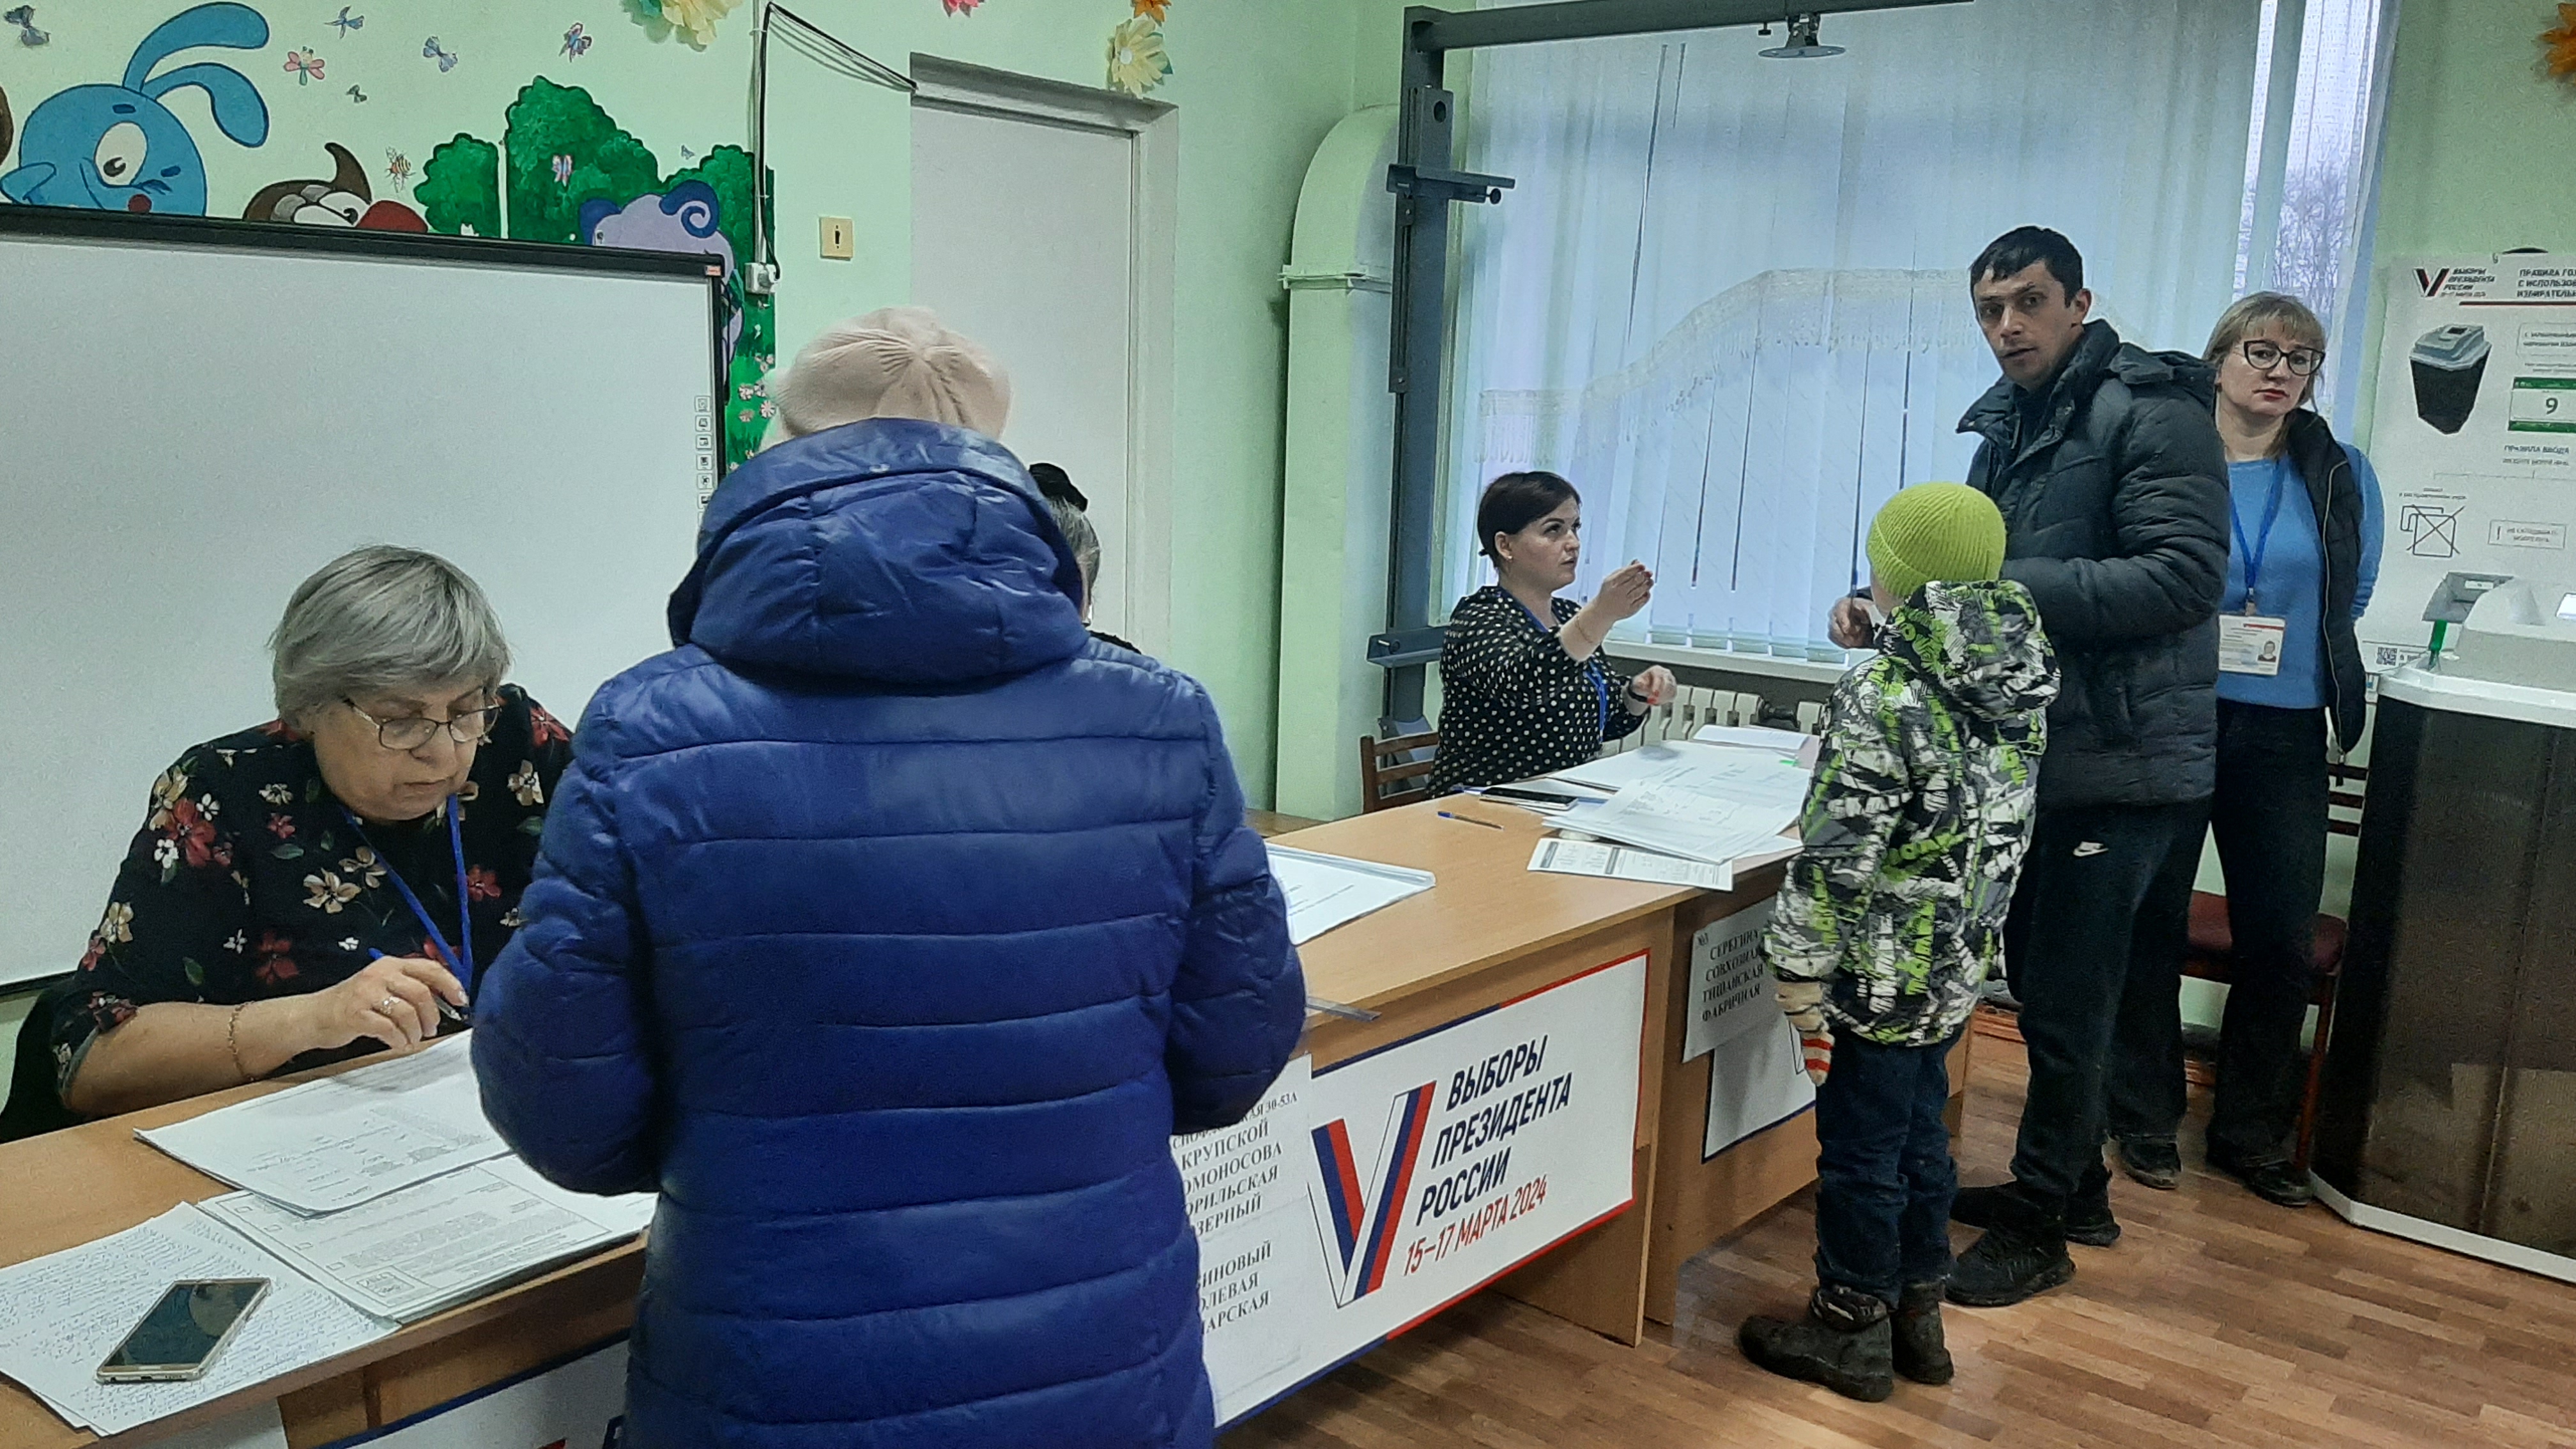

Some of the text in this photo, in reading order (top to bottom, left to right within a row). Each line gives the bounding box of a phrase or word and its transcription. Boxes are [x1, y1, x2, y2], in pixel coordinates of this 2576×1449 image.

[2519, 268, 2576, 277] ПРАВИЛА ГО
[2546, 397, 2558, 415] 9
[1446, 1034, 1548, 1112] ВЫБОРЫ
[1181, 1117, 1269, 1171] КРУПСКОЙ
[1431, 1072, 1572, 1170] ПРЕЗИДЕНТА
[1184, 1142, 1282, 1195] ОМОНОСОВА
[1185, 1164, 1278, 1216] ОРИЛЬСКАЯ
[1416, 1146, 1512, 1227] РОССИИ
[1196, 1192, 1262, 1237] ЗЕРНЫЙ
[1454, 1193, 1510, 1252] МАРТА
[1509, 1174, 1547, 1220] 2024
[1198, 1238, 1271, 1289] ИНОВЫЙ
